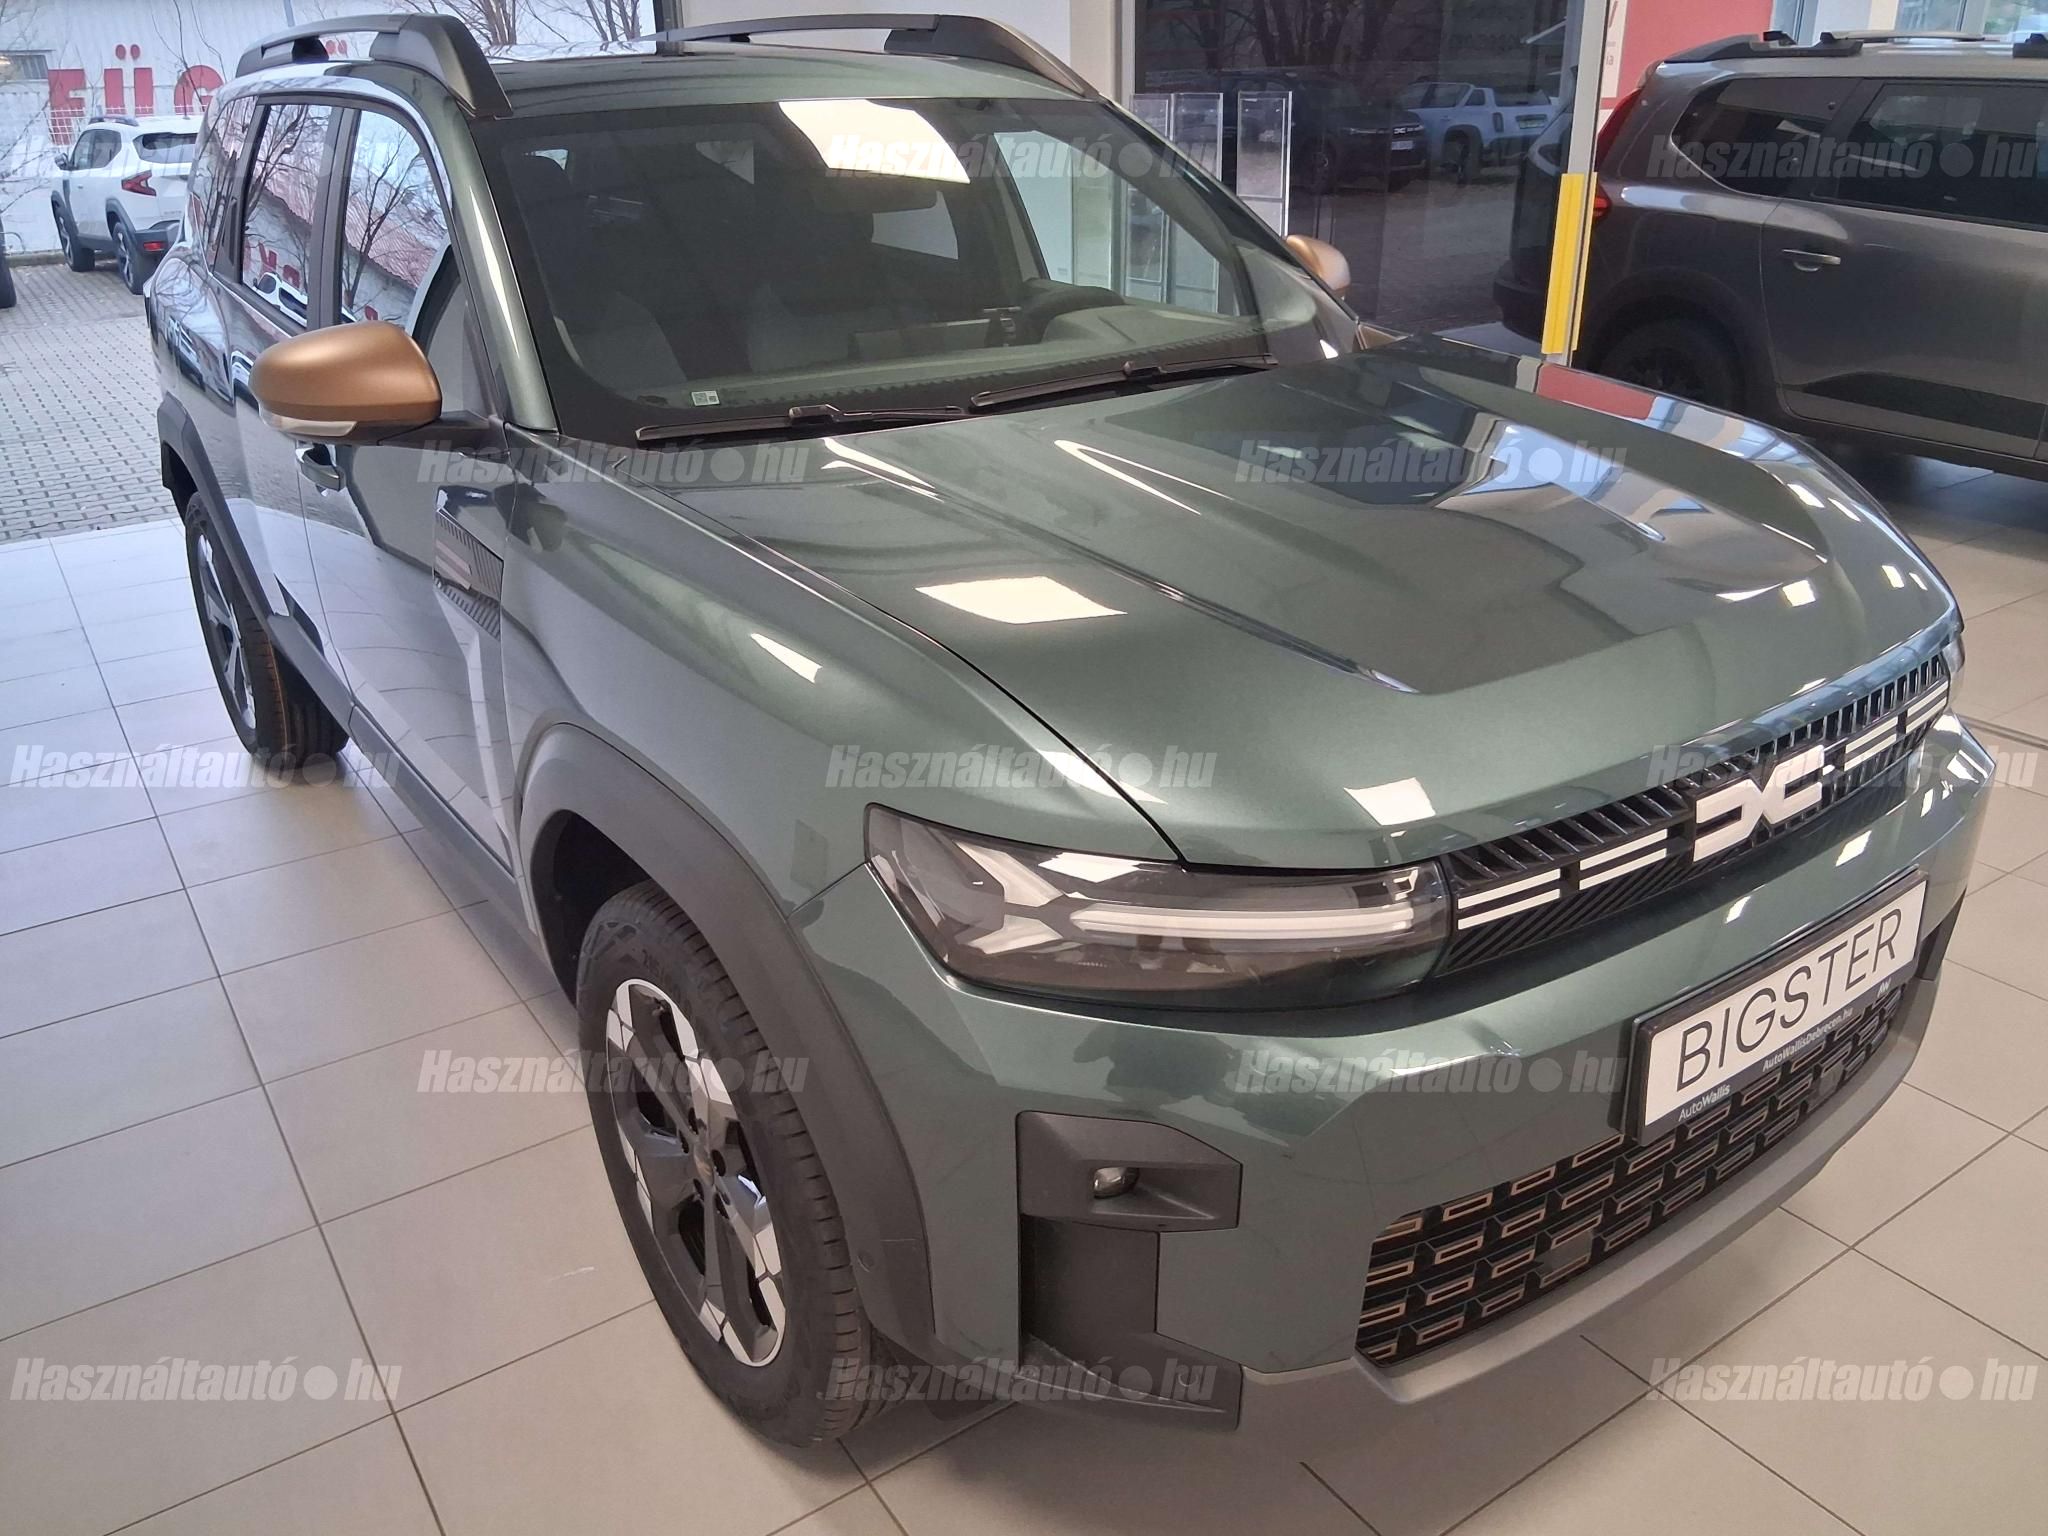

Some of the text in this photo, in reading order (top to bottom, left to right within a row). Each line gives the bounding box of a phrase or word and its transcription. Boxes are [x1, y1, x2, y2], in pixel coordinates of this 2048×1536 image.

[1677, 908, 1903, 1092] BIGSTER
[1762, 1008, 1853, 1072] AutoWallisDebrecen.hu
[1678, 1083, 1731, 1122] AutoWallis
